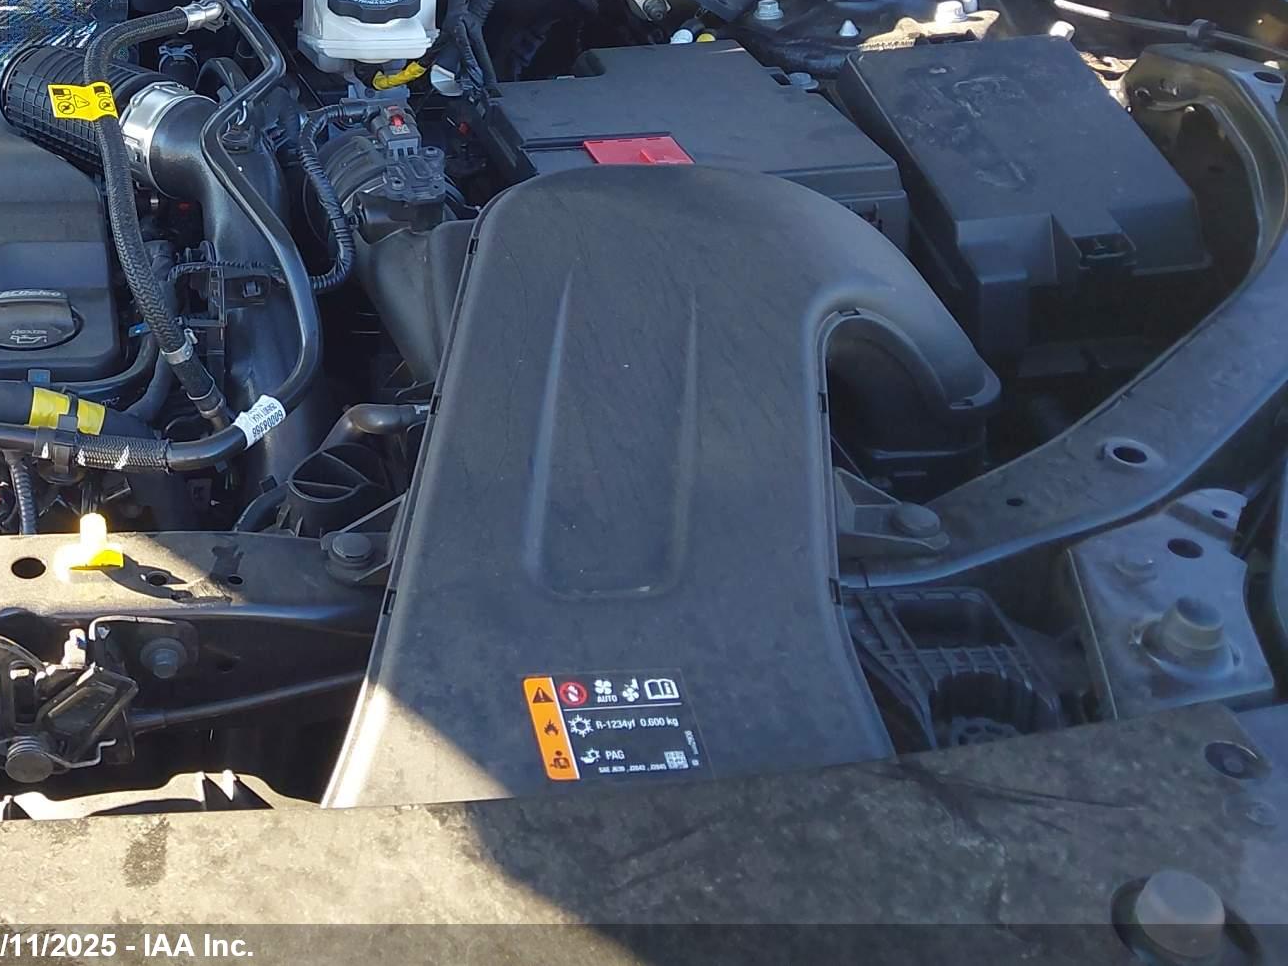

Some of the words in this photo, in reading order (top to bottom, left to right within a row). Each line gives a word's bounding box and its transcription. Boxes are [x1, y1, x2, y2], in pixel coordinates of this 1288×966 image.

[597, 695, 617, 703] AUTO
[596, 718, 635, 730] R-1234yf
[640, 717, 665, 727] 0.600
[666, 716, 679, 727] kg
[606, 750, 625, 760] PAG
